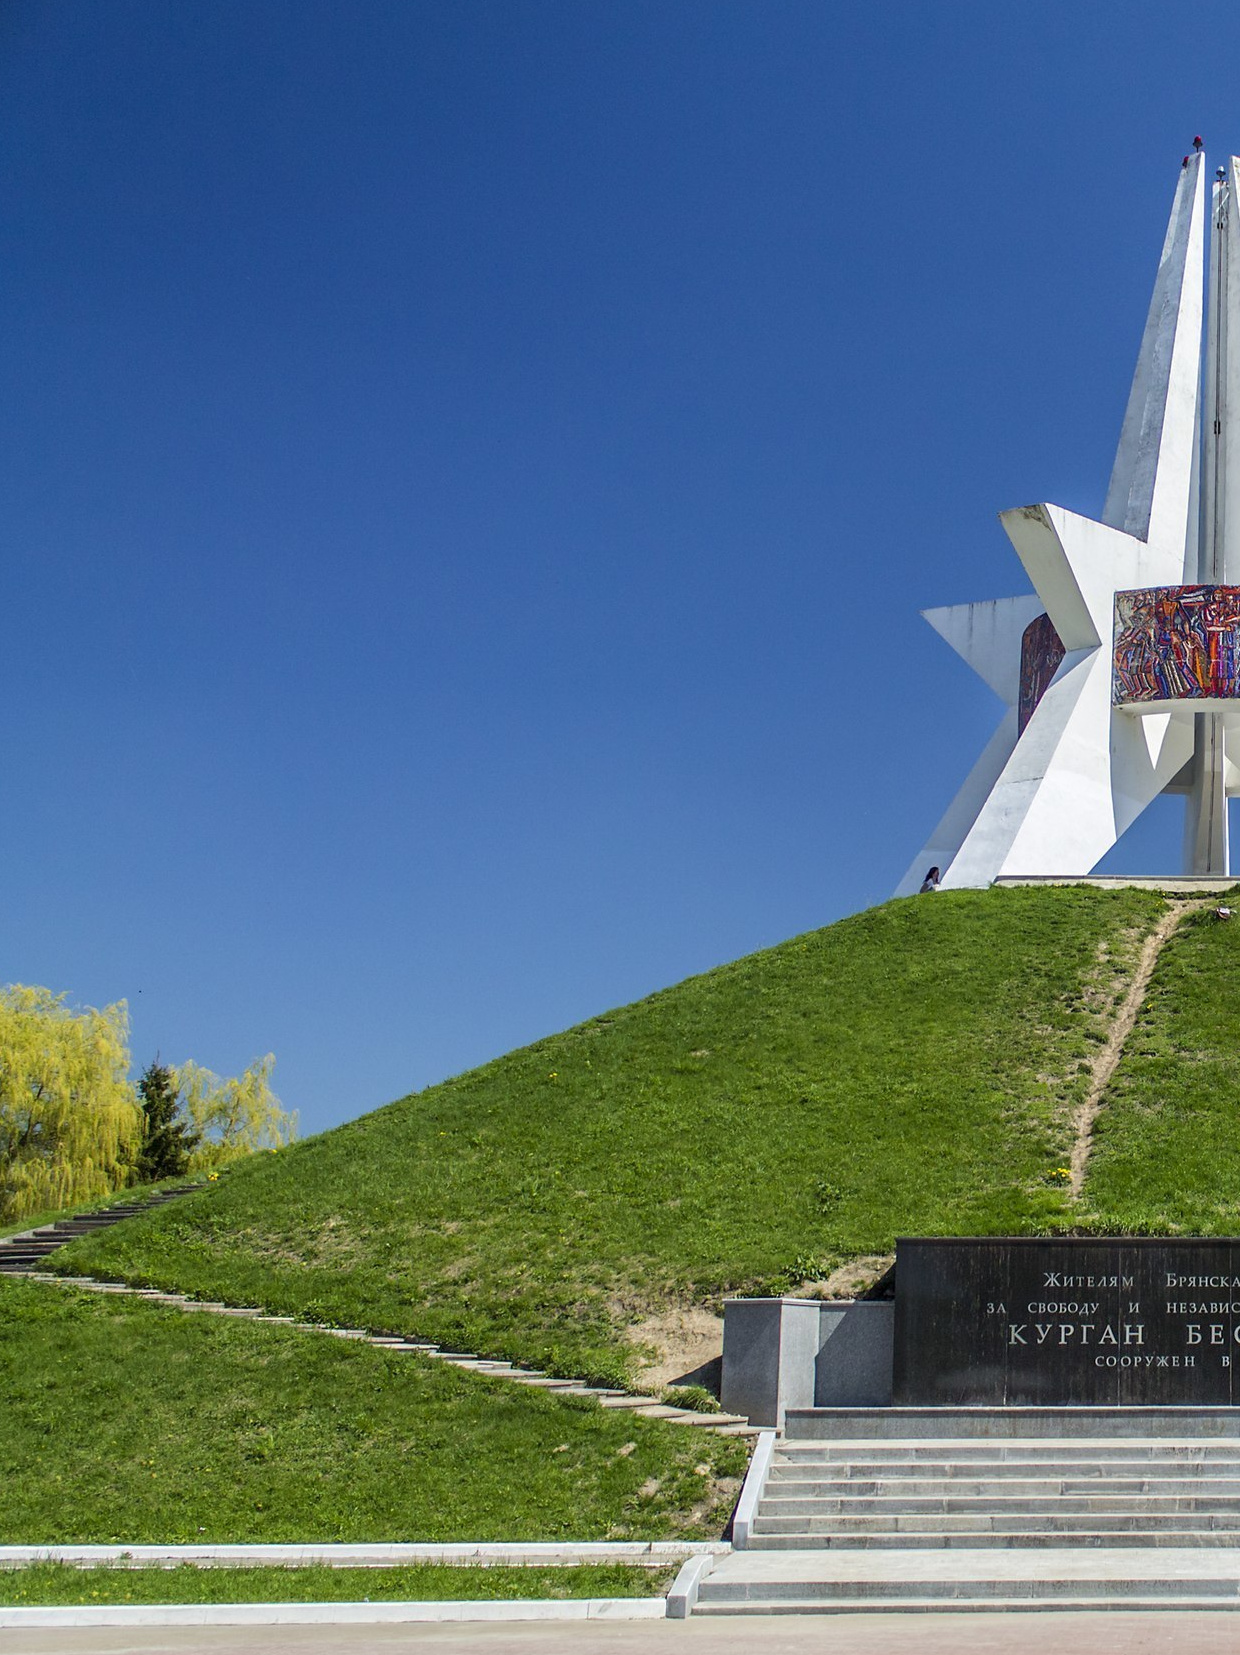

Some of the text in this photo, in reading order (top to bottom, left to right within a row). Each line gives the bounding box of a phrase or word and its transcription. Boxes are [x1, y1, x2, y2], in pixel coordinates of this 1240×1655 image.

[986, 1302, 1007, 1314] ЗА
[1027, 1302, 1100, 1315] СВОБОДУ
[1128, 1302, 1140, 1314] И
[1008, 1324, 1145, 1345] КУРГАН
[1094, 1355, 1196, 1367] СООРУЖЕН
[1221, 1355, 1231, 1367] В
